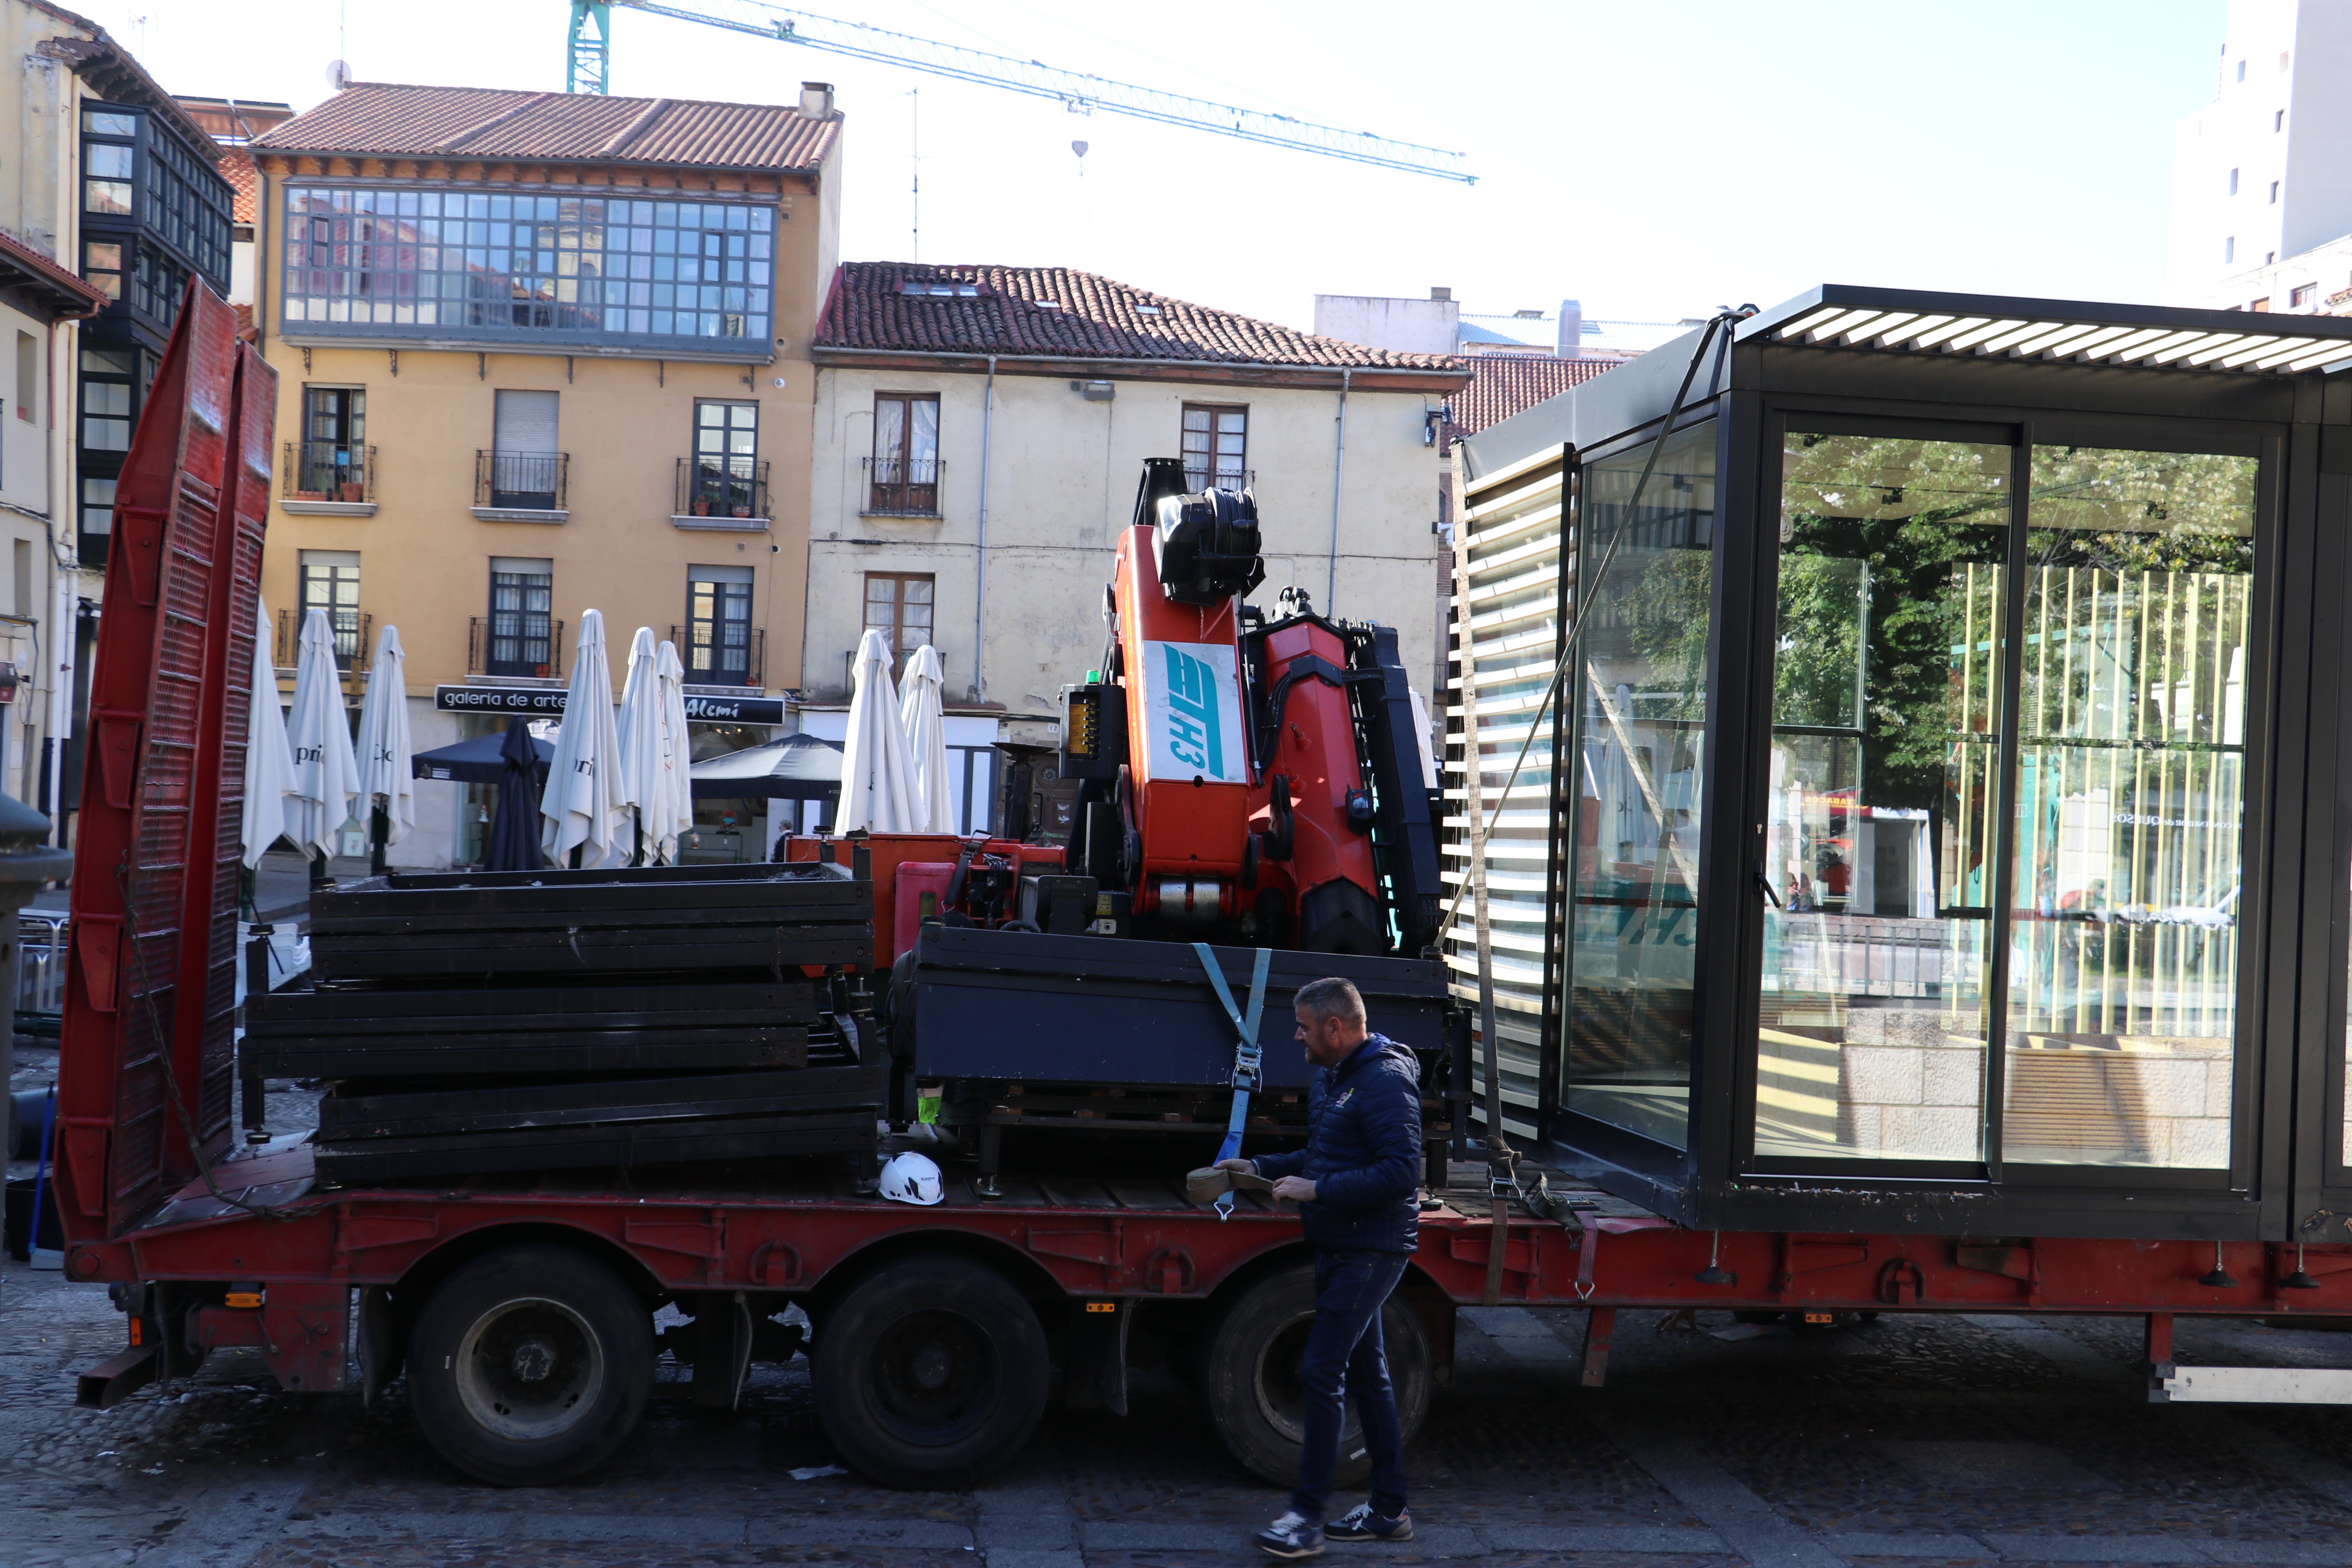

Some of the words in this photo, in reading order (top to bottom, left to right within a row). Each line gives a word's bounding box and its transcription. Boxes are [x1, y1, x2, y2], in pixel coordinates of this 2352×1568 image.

[445, 692, 501, 706] galeria
[507, 693, 528, 706] de
[534, 695, 567, 708] arte
